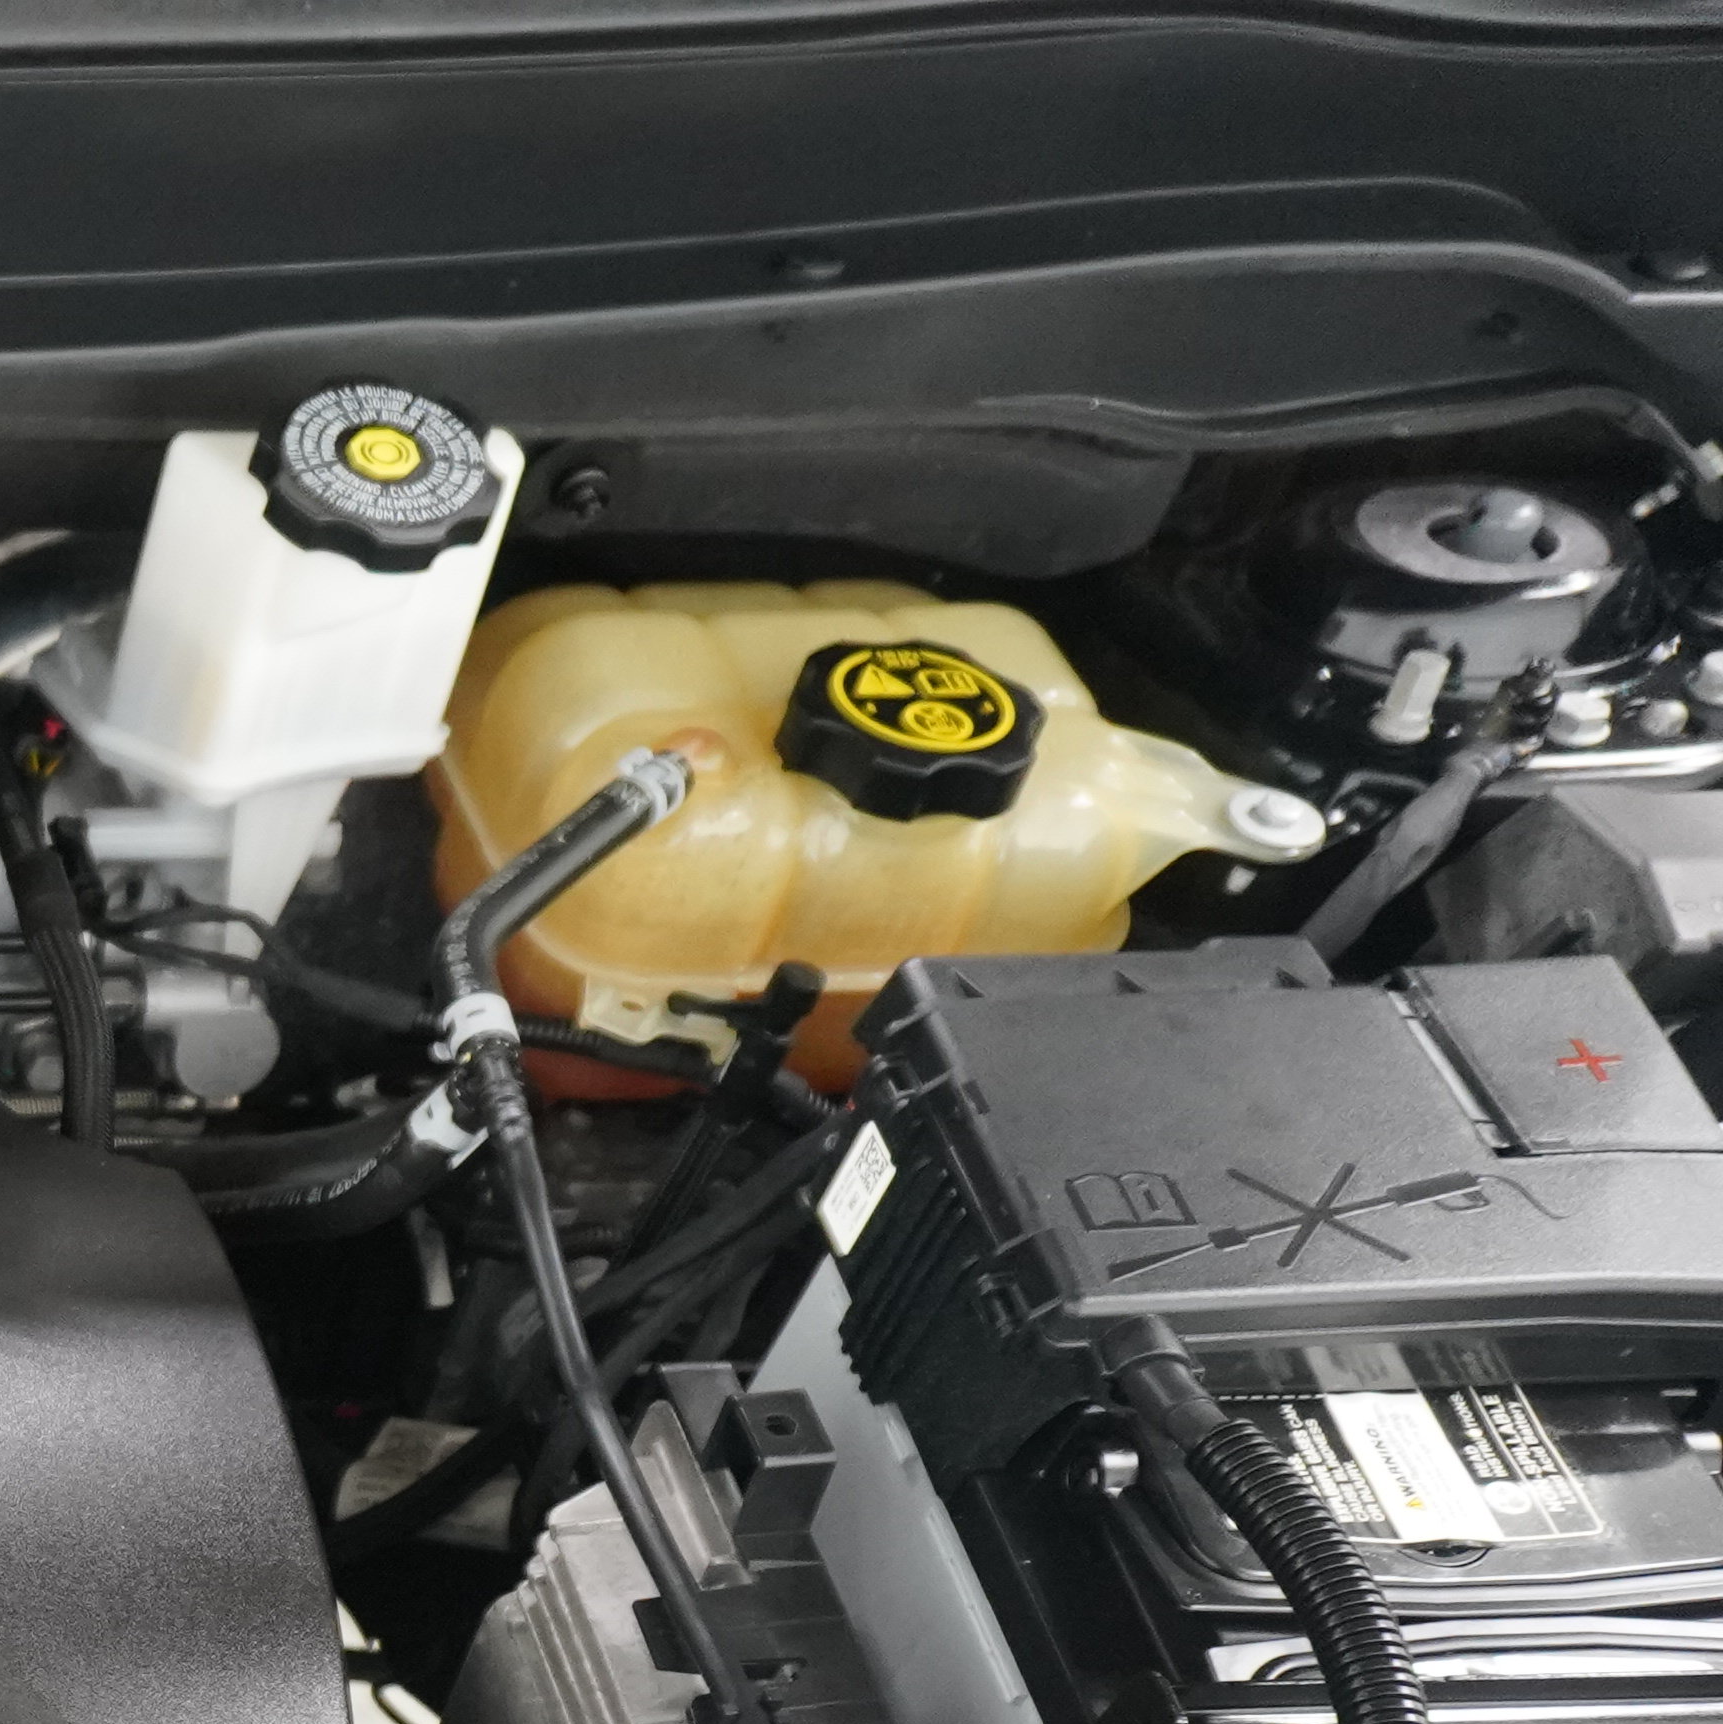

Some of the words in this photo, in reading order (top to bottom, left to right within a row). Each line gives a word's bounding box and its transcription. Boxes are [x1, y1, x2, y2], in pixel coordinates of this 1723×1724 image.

[354, 385, 414, 402] BOUCHON
[329, 480, 377, 506] BEFORE
[389, 481, 430, 496] CLEAN
[321, 489, 358, 512] FLUID
[357, 504, 393, 521] FROM
[395, 511, 406, 521] A
[405, 503, 452, 521] SEALED
[1280, 1403, 1303, 1427] CAN
[1506, 1403, 1539, 1442] Battery
[1303, 1417, 1349, 1480] BLINDNESS
[1448, 1391, 1508, 1477] INSTRUTIONS.
[1463, 1444, 1493, 1477] READ
[1481, 1393, 1566, 1512] NON-SPILLABLE
[1529, 1444, 1558, 1472] Acid
[1336, 1483, 1370, 1521] CAUSE
